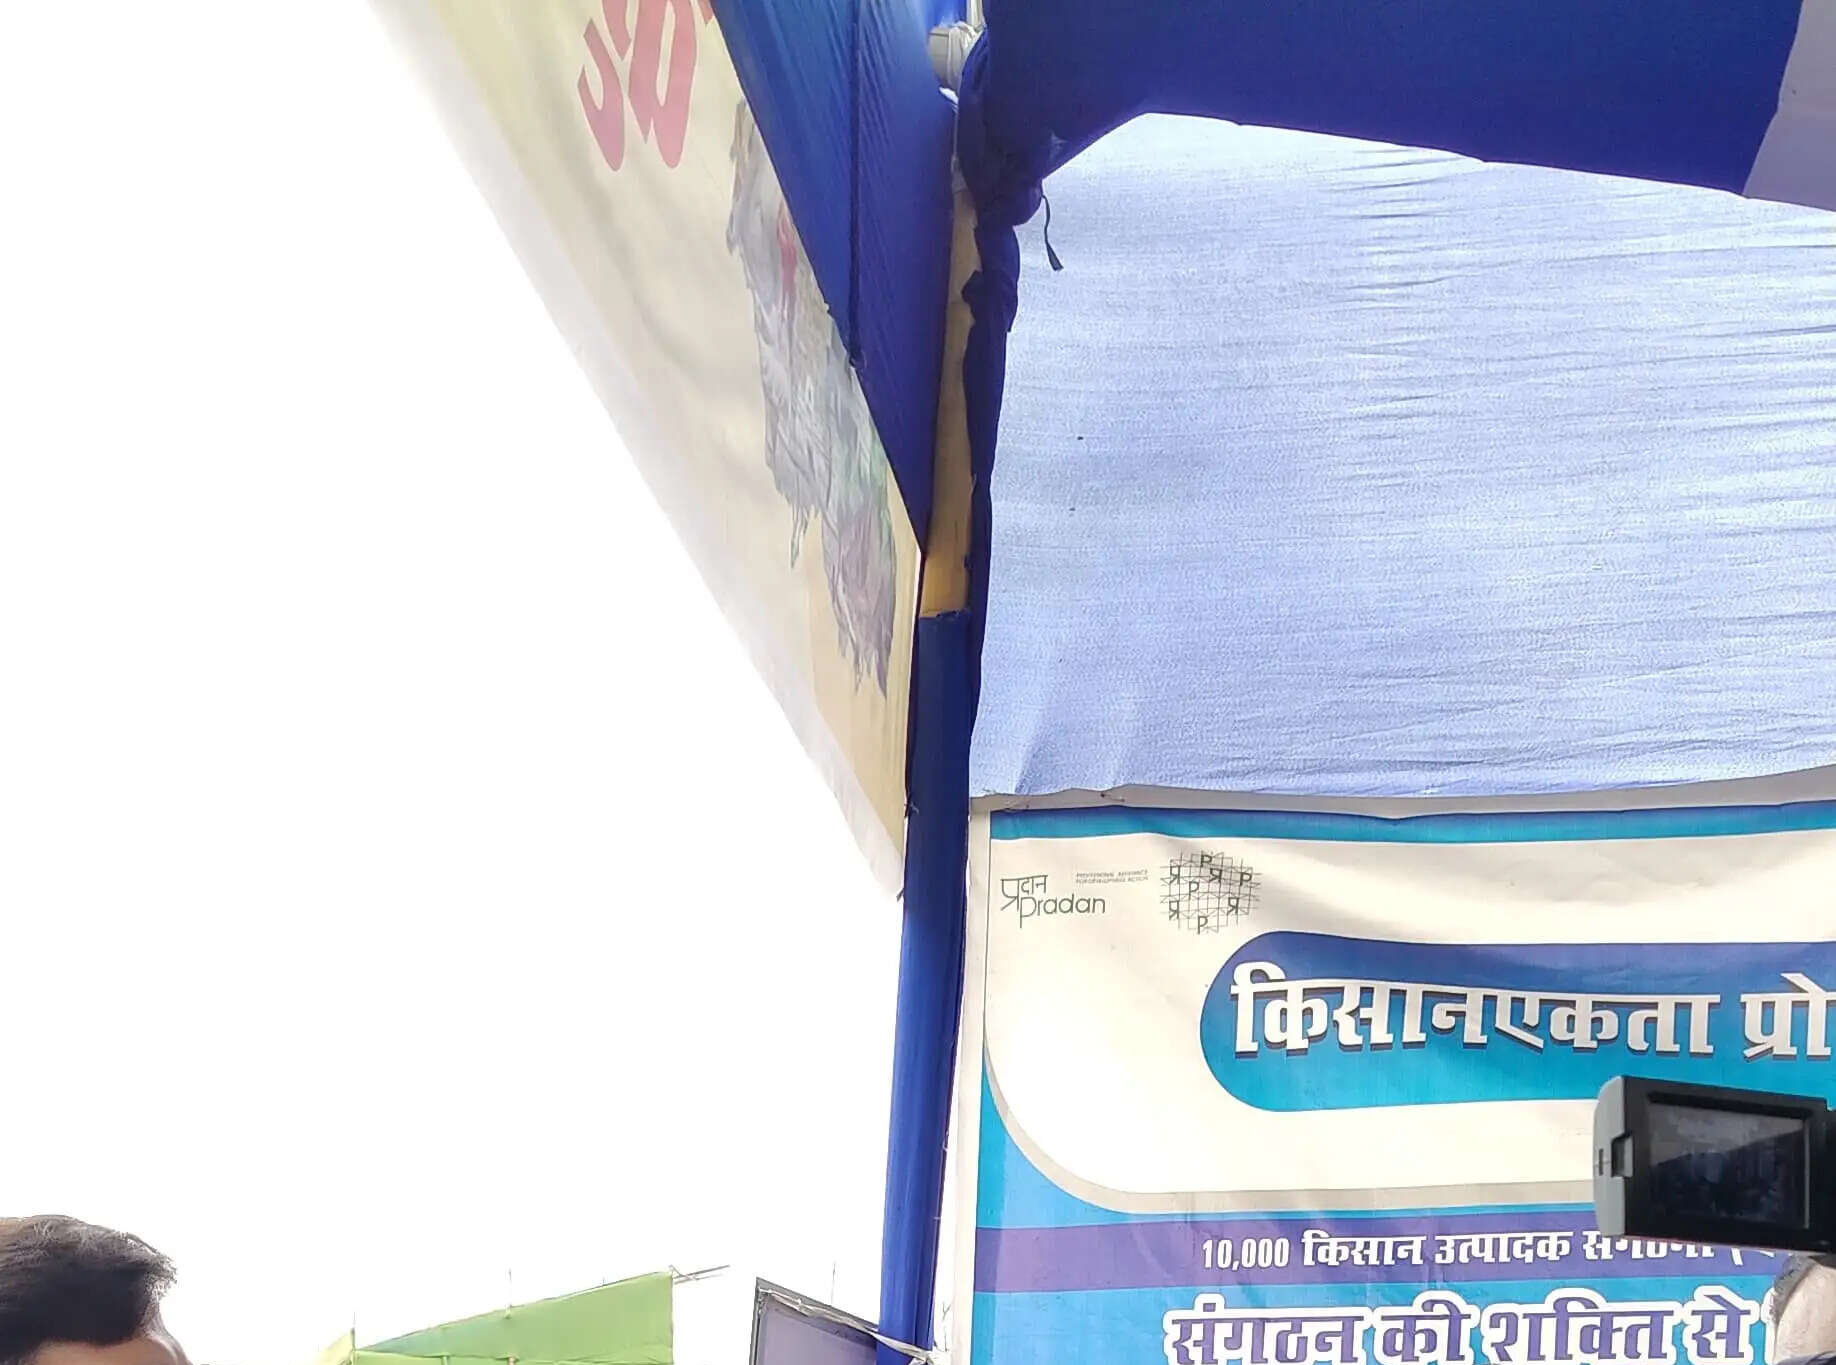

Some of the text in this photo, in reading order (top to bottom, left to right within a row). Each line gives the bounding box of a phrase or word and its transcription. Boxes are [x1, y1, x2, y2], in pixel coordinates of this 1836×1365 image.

[1230, 961, 1721, 1053] किसानएकता
[1202, 1237, 1290, 1270] 10,000
[1301, 1229, 1428, 1267] किसान
[1433, 1230, 1572, 1264] उत्पादक
[1378, 1296, 1472, 1365] की
[1486, 1294, 1679, 1364] शक्ति
[1688, 1291, 1753, 1361] से
